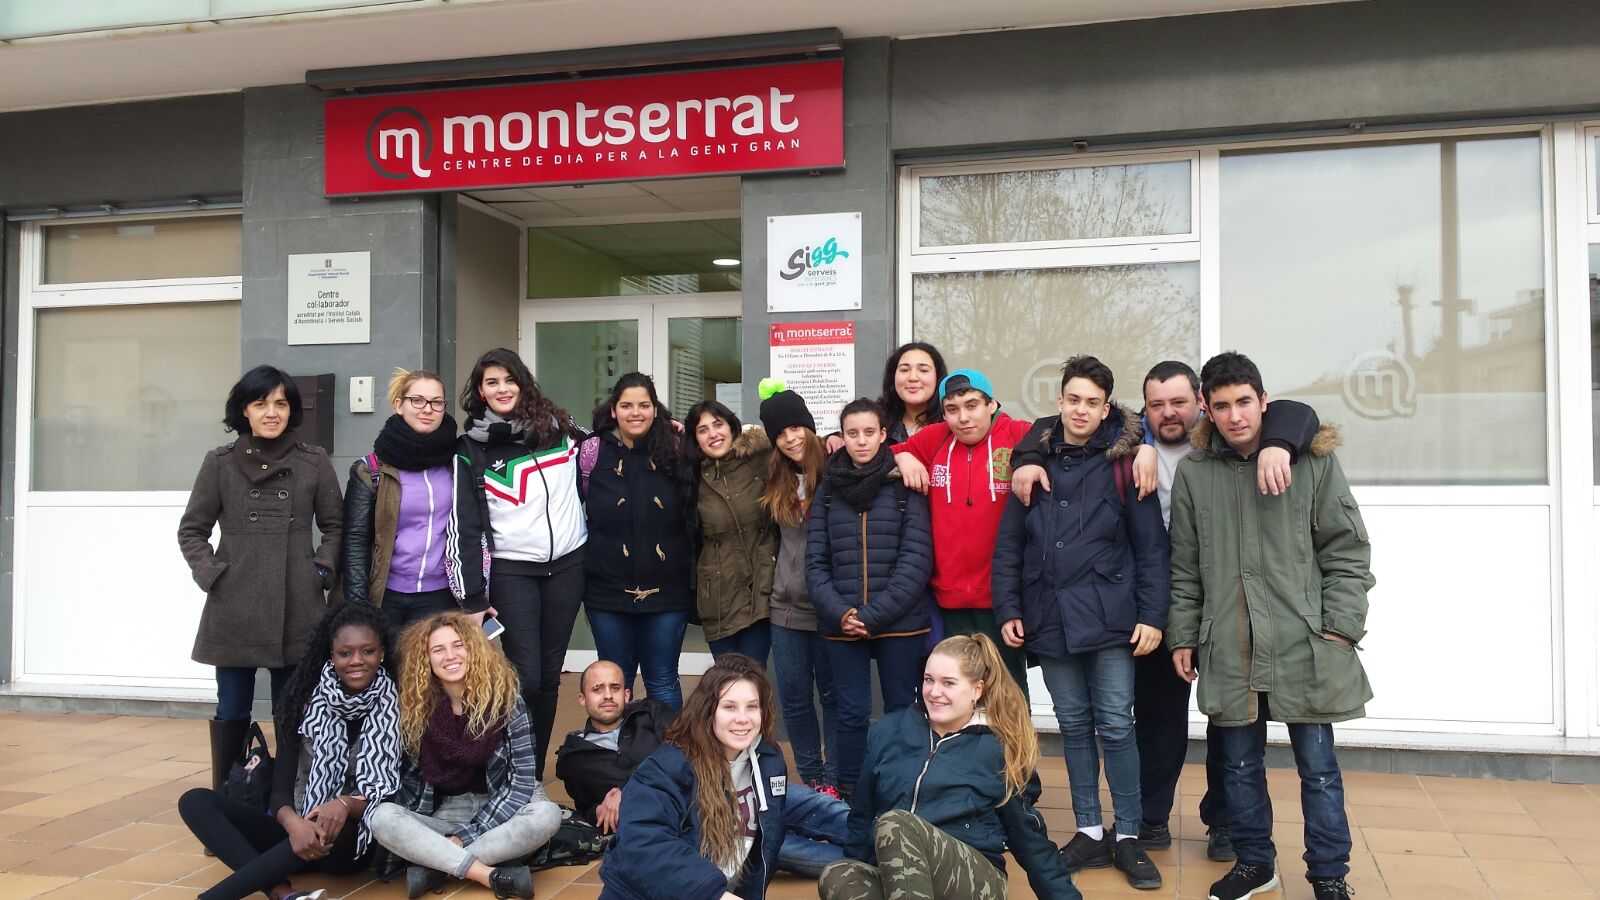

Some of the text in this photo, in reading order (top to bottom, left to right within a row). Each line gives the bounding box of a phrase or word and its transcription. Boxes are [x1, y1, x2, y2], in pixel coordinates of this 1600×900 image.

[443, 87, 799, 154] montserrat
[443, 138, 800, 172] CENTRE DE DIA PER A LA GENT GRAN
[317, 290, 340, 299] Centre
[787, 327, 853, 337] montserrat
